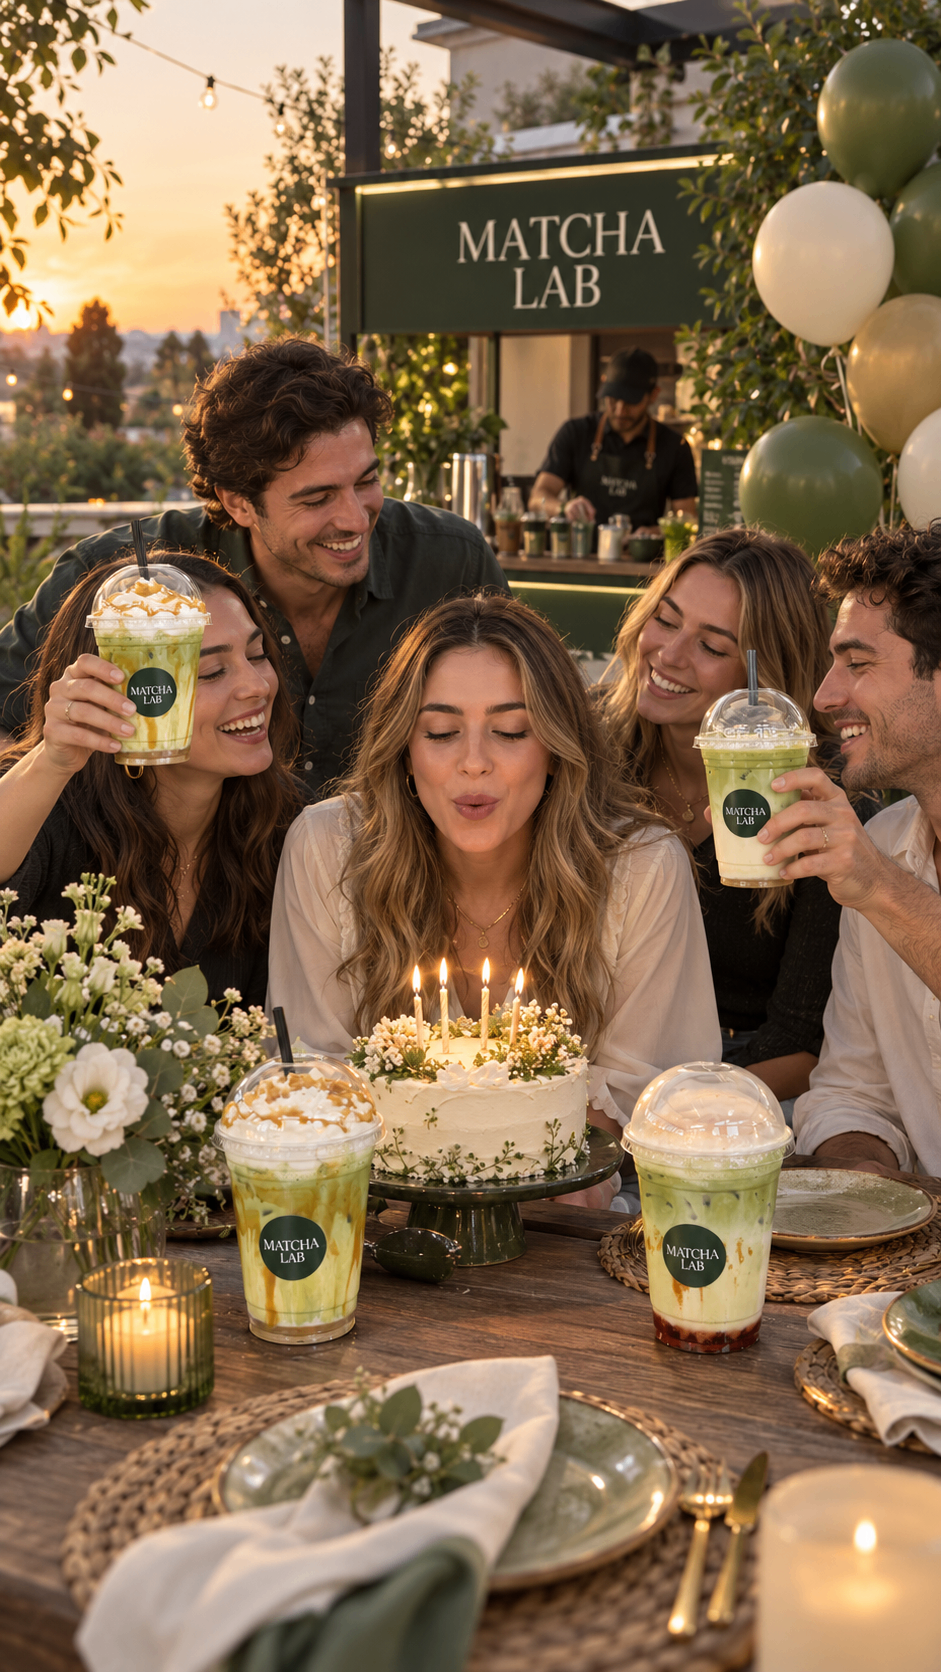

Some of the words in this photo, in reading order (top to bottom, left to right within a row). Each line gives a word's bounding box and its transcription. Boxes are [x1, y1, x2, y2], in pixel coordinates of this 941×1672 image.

[457, 209, 666, 264] MATCHA
[513, 264, 601, 310] LAB
[130, 685, 173, 696] MATCHA
[143, 695, 163, 705] LAB
[725, 806, 766, 816] MATCHA
[736, 816, 755, 825] LAB
[263, 1238, 320, 1251] MATCHA
[280, 1252, 305, 1264] LAB
[666, 1244, 719, 1260] MATCHA
[681, 1258, 705, 1271] LAB
